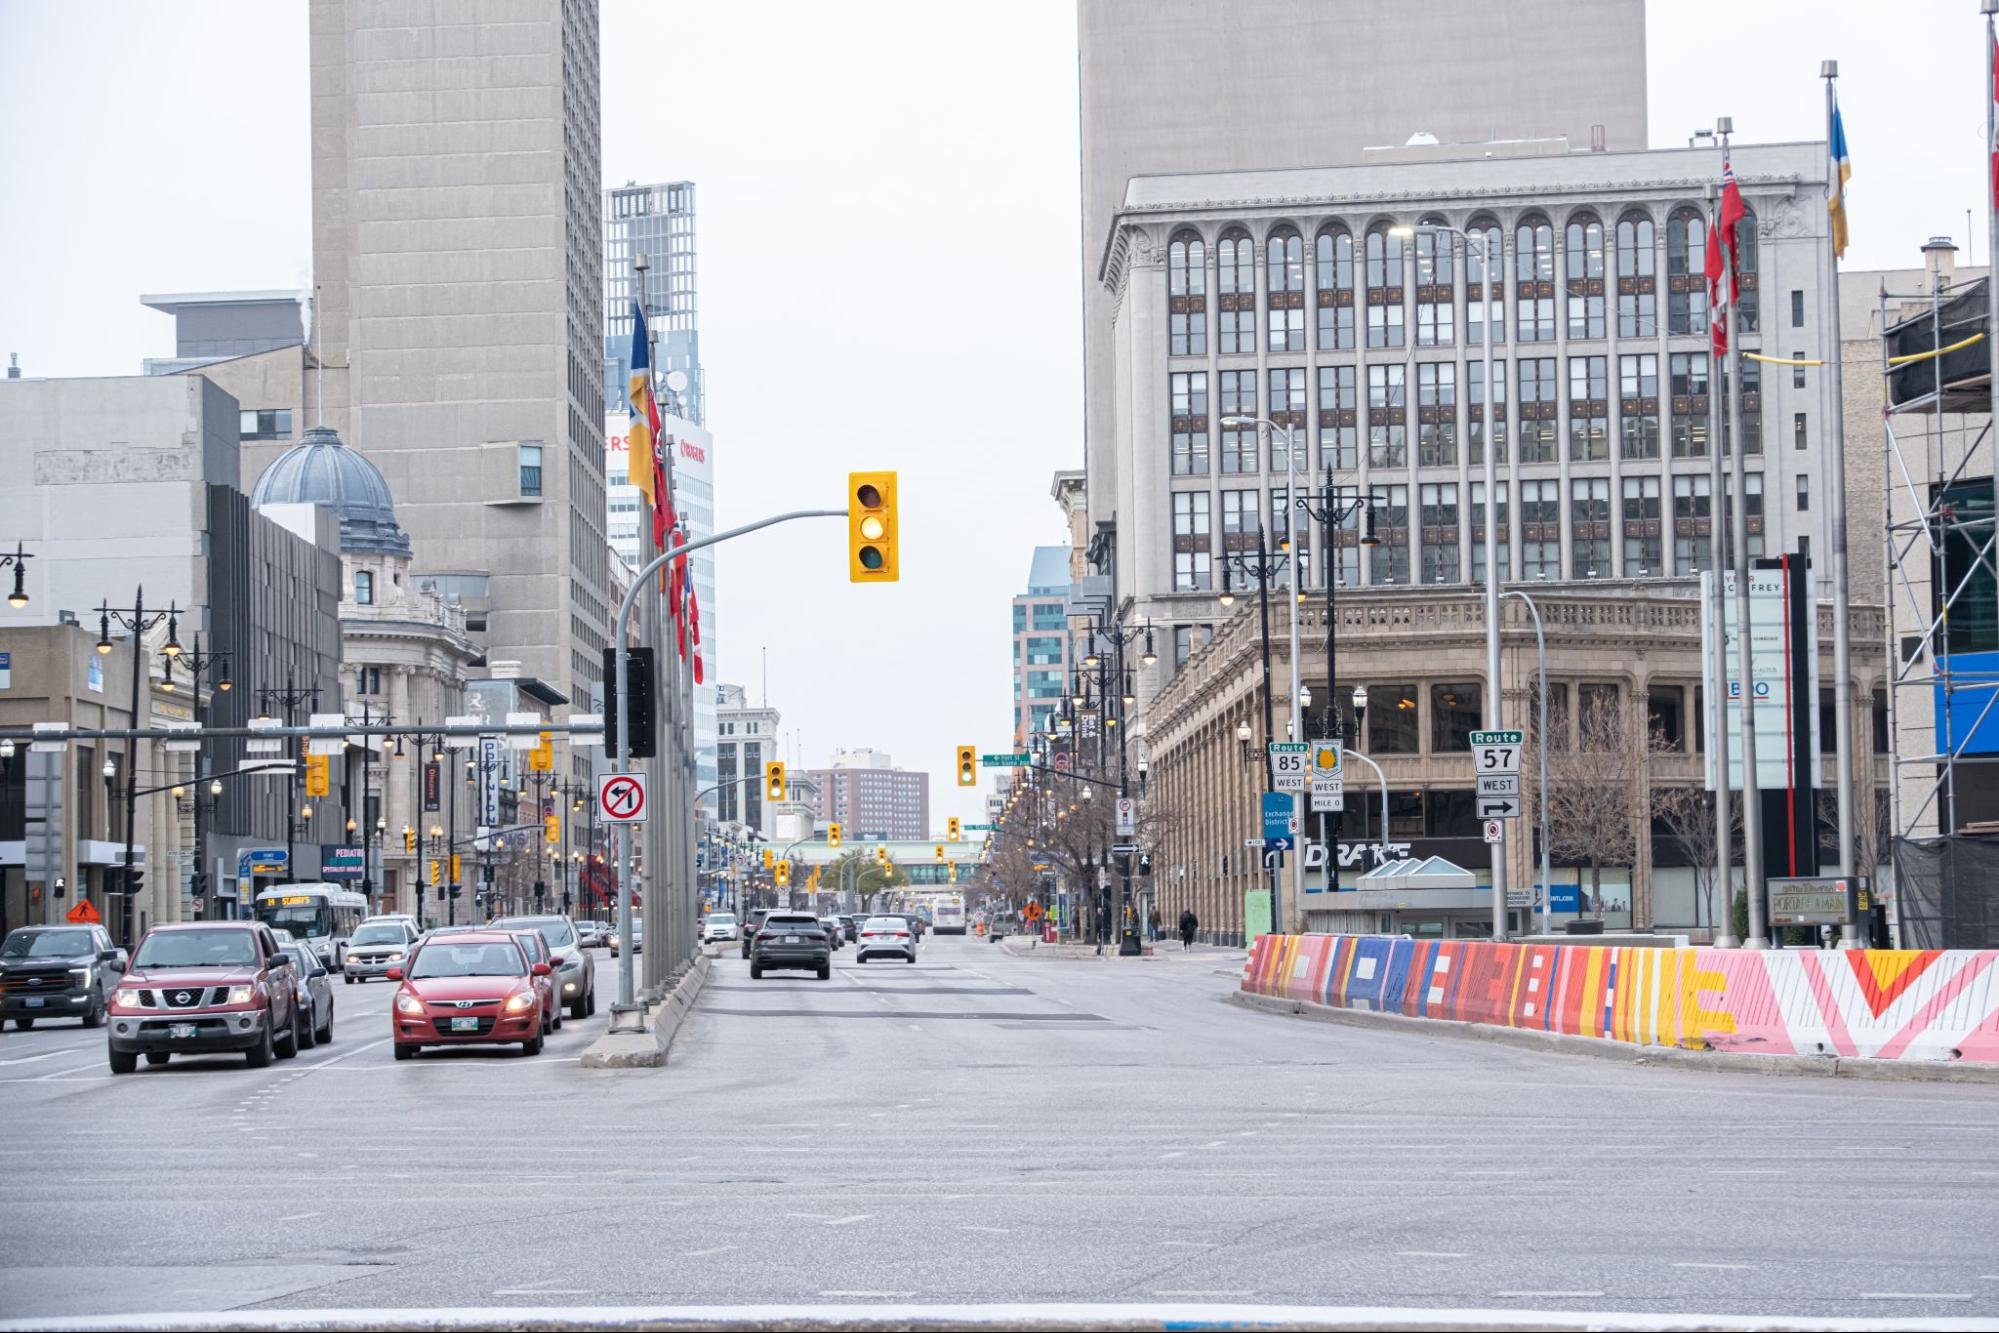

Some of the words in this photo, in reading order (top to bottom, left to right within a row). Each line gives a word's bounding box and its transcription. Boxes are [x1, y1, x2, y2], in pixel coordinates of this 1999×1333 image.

[1731, 682, 1769, 695] BO
[1475, 733, 1517, 743] Route
[1279, 756, 1300, 770] 85
[1484, 749, 1513, 768] 57
[1277, 779, 1302, 787] WEST
[1315, 783, 1339, 791] WEST
[1483, 780, 1512, 790] WEST
